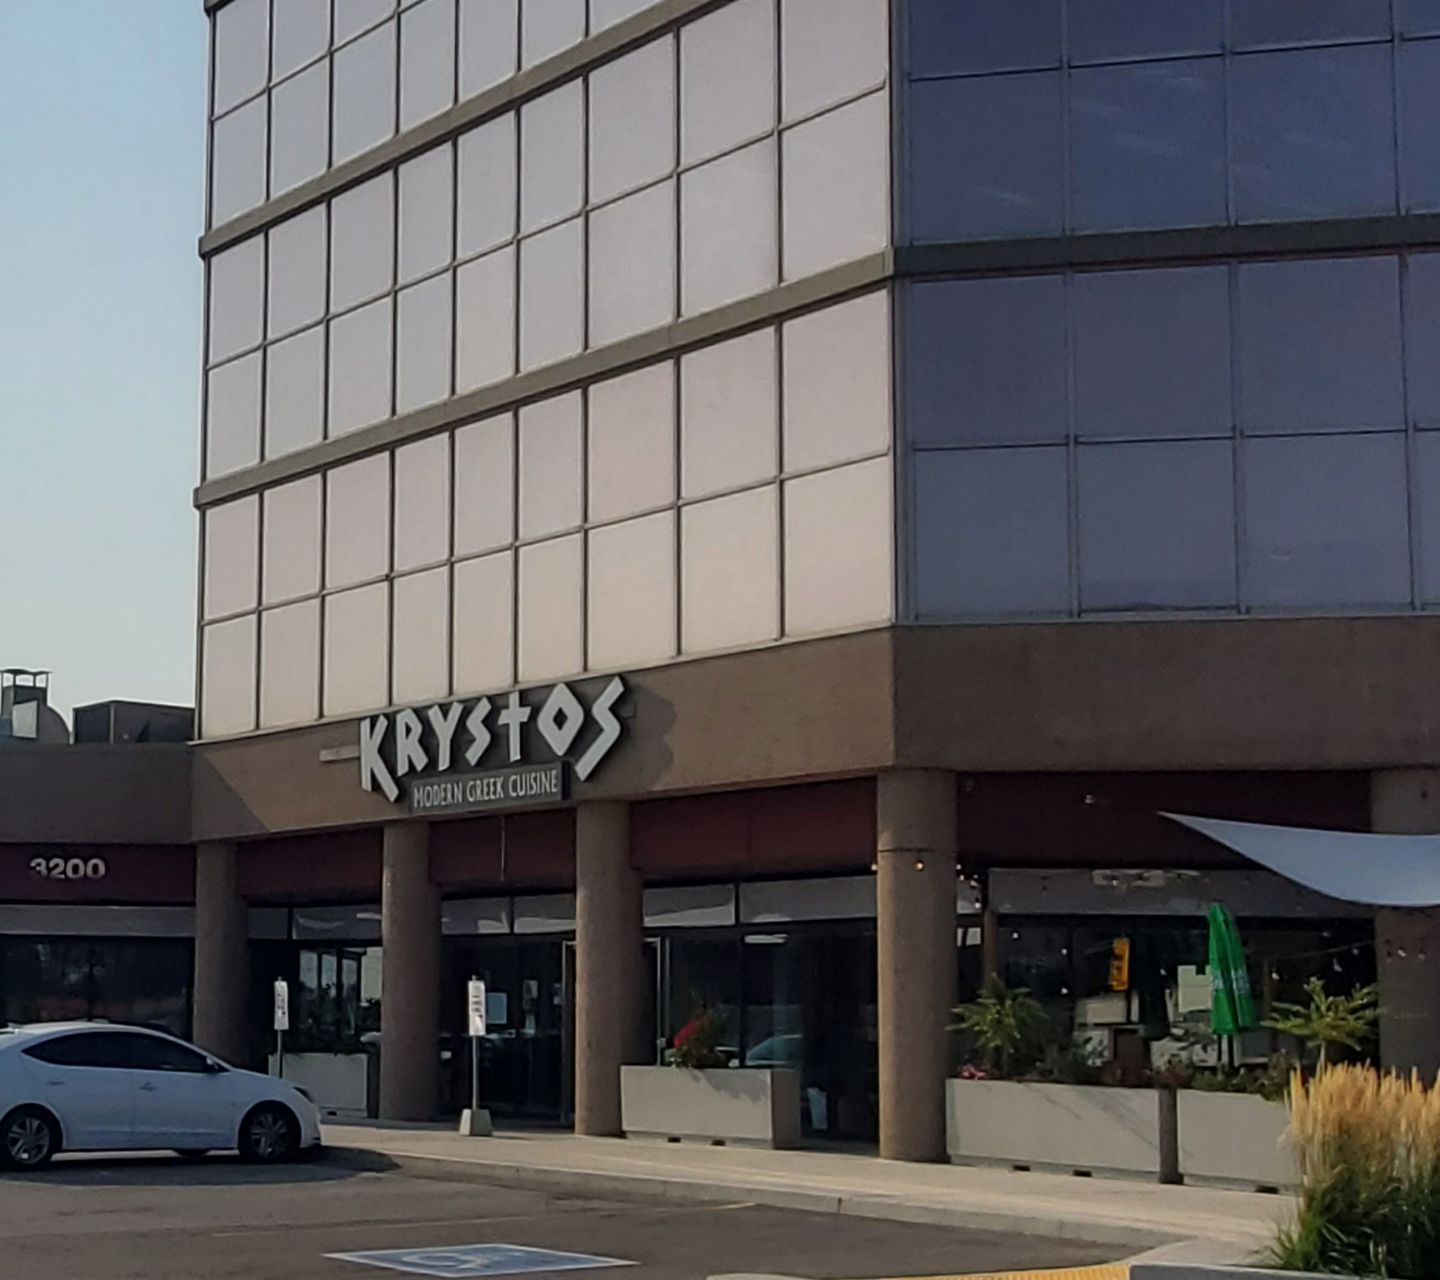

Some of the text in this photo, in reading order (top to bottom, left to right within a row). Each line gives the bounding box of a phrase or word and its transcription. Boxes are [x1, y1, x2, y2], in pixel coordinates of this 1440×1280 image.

[414, 770, 558, 808] MODERN GREEK CUISINE
[30, 858, 106, 879] 3200
